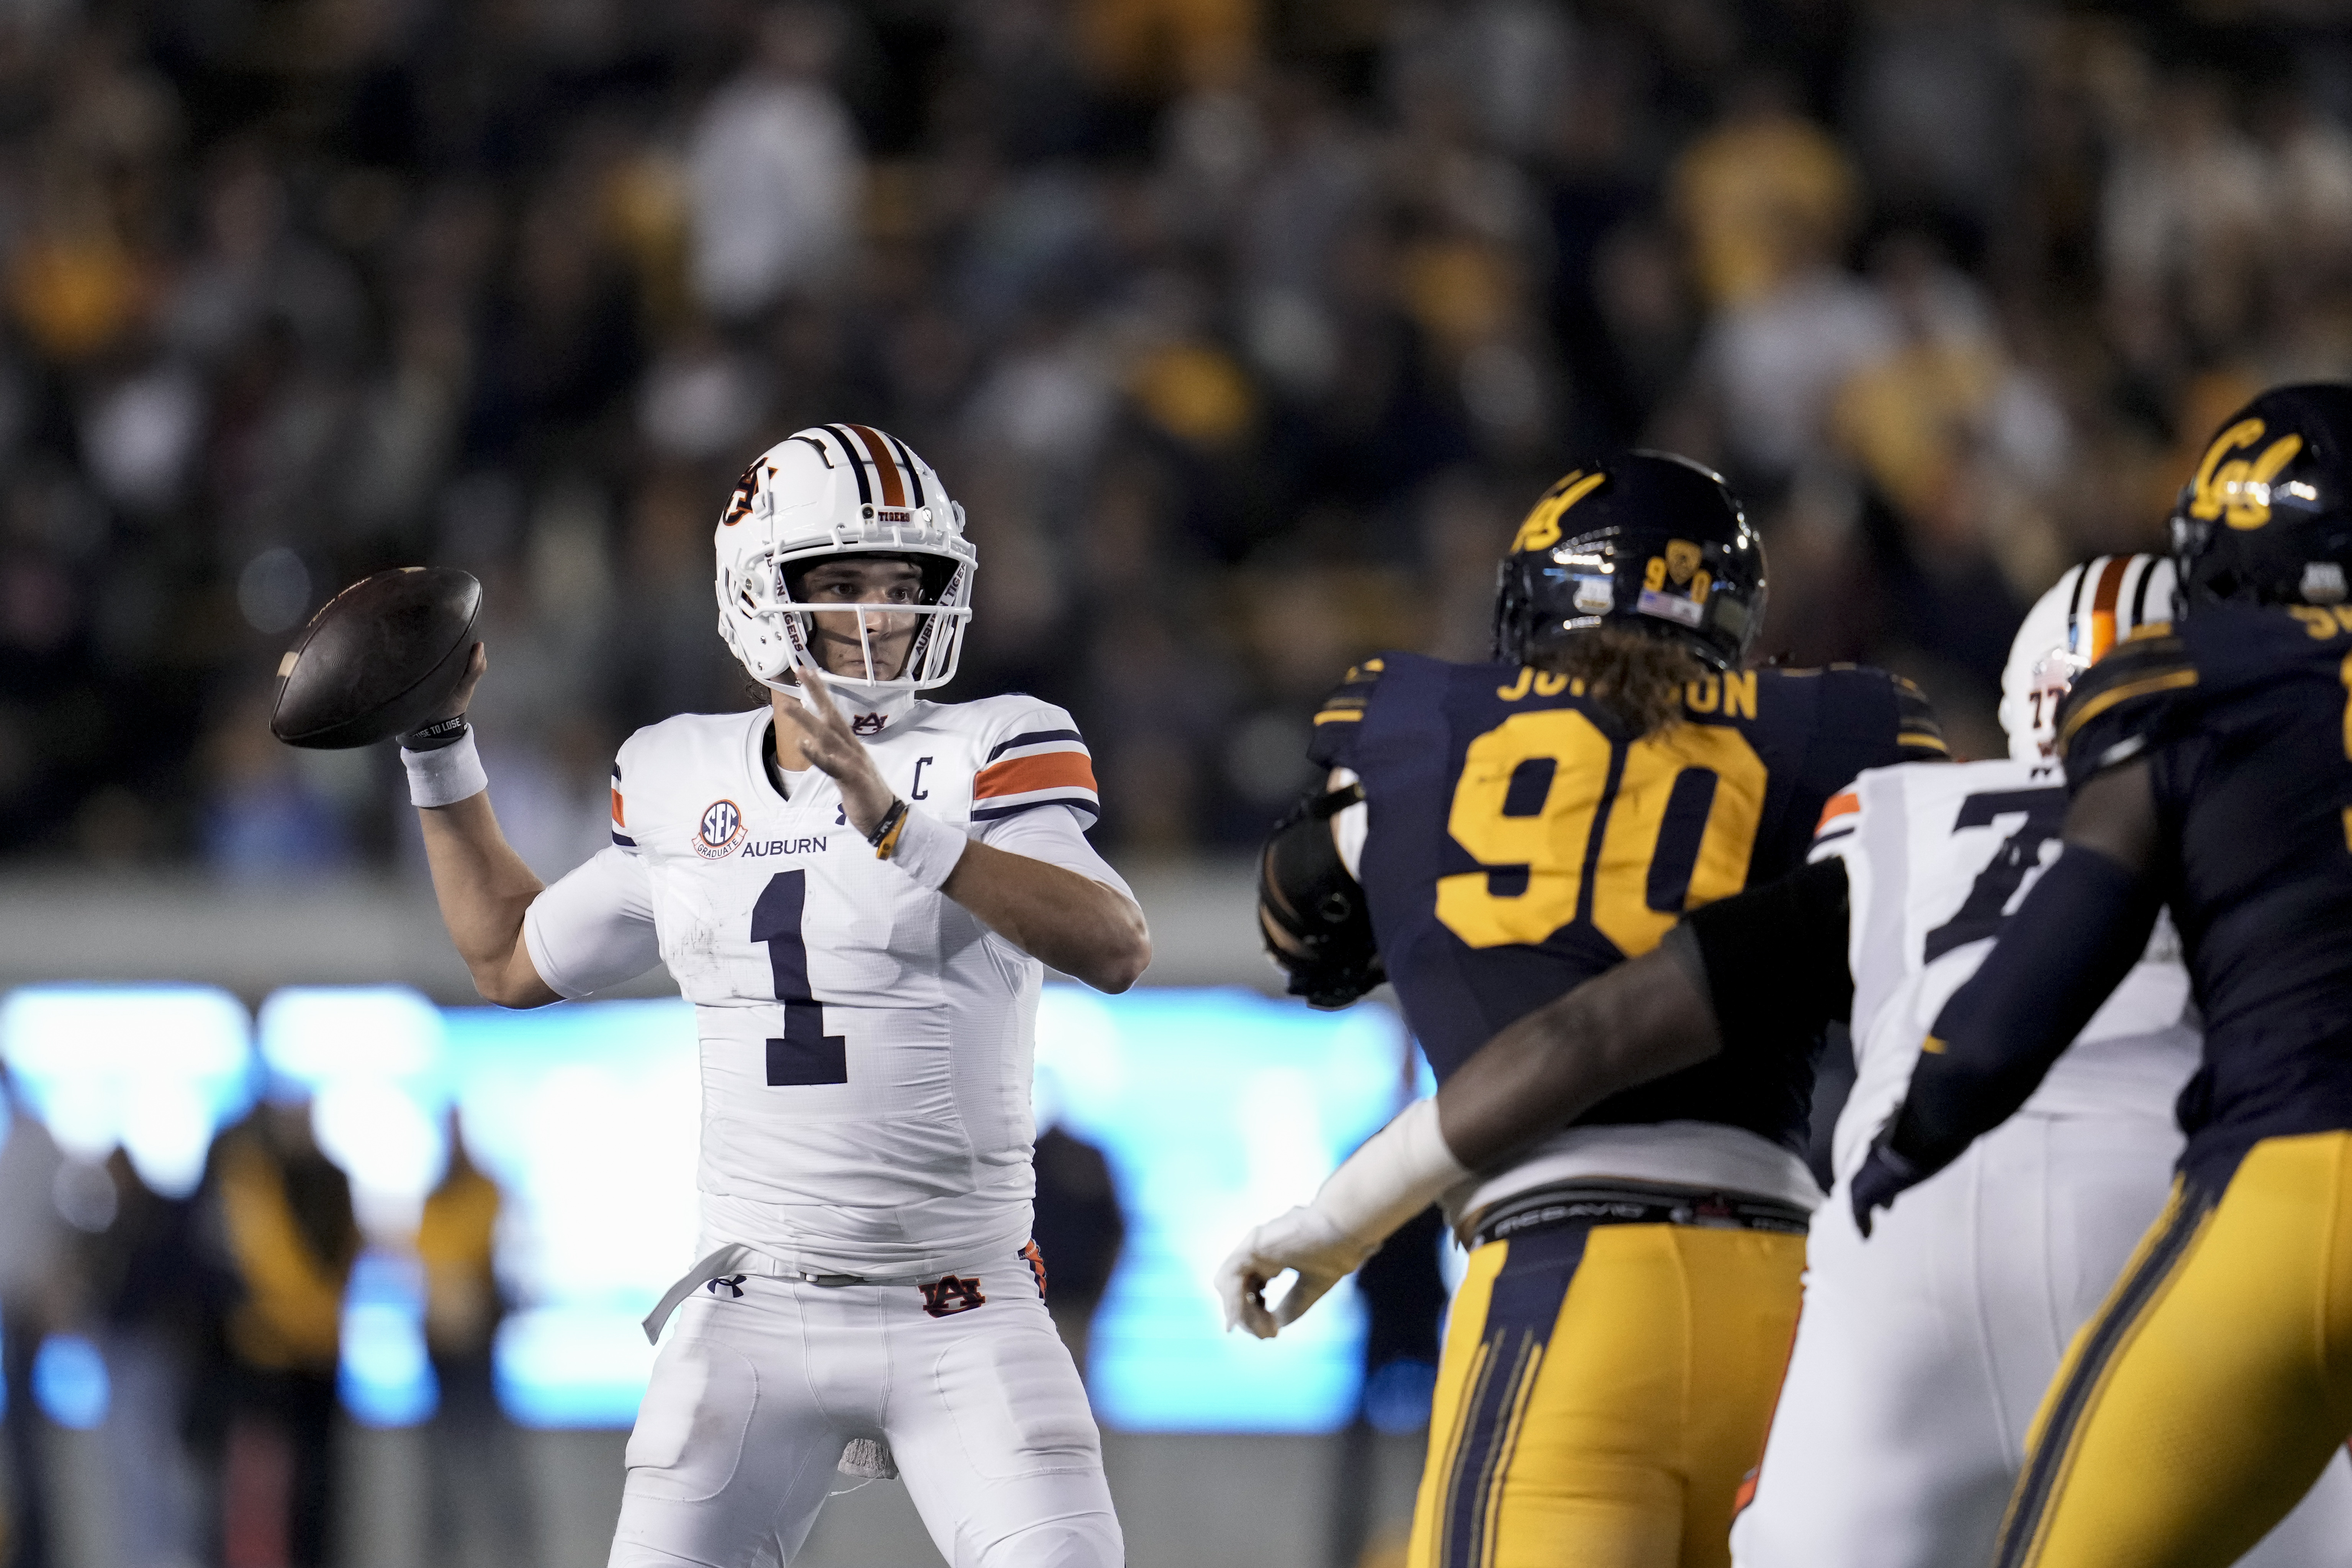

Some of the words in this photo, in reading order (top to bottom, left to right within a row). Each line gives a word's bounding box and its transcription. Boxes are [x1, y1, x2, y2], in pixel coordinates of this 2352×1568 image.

[2188, 417, 2303, 530] Cal
[878, 512, 910, 522] TIGERS
[1497, 666, 1757, 721] JOON
[430, 725, 441, 735] TO
[441, 717, 461, 731] LOSE
[911, 756, 933, 800] C
[704, 803, 737, 844] SEC
[1434, 709, 1769, 959] 90
[697, 838, 739, 858] GRADUATE
[741, 836, 827, 858] AUBURN
[750, 869, 848, 1086] 1
